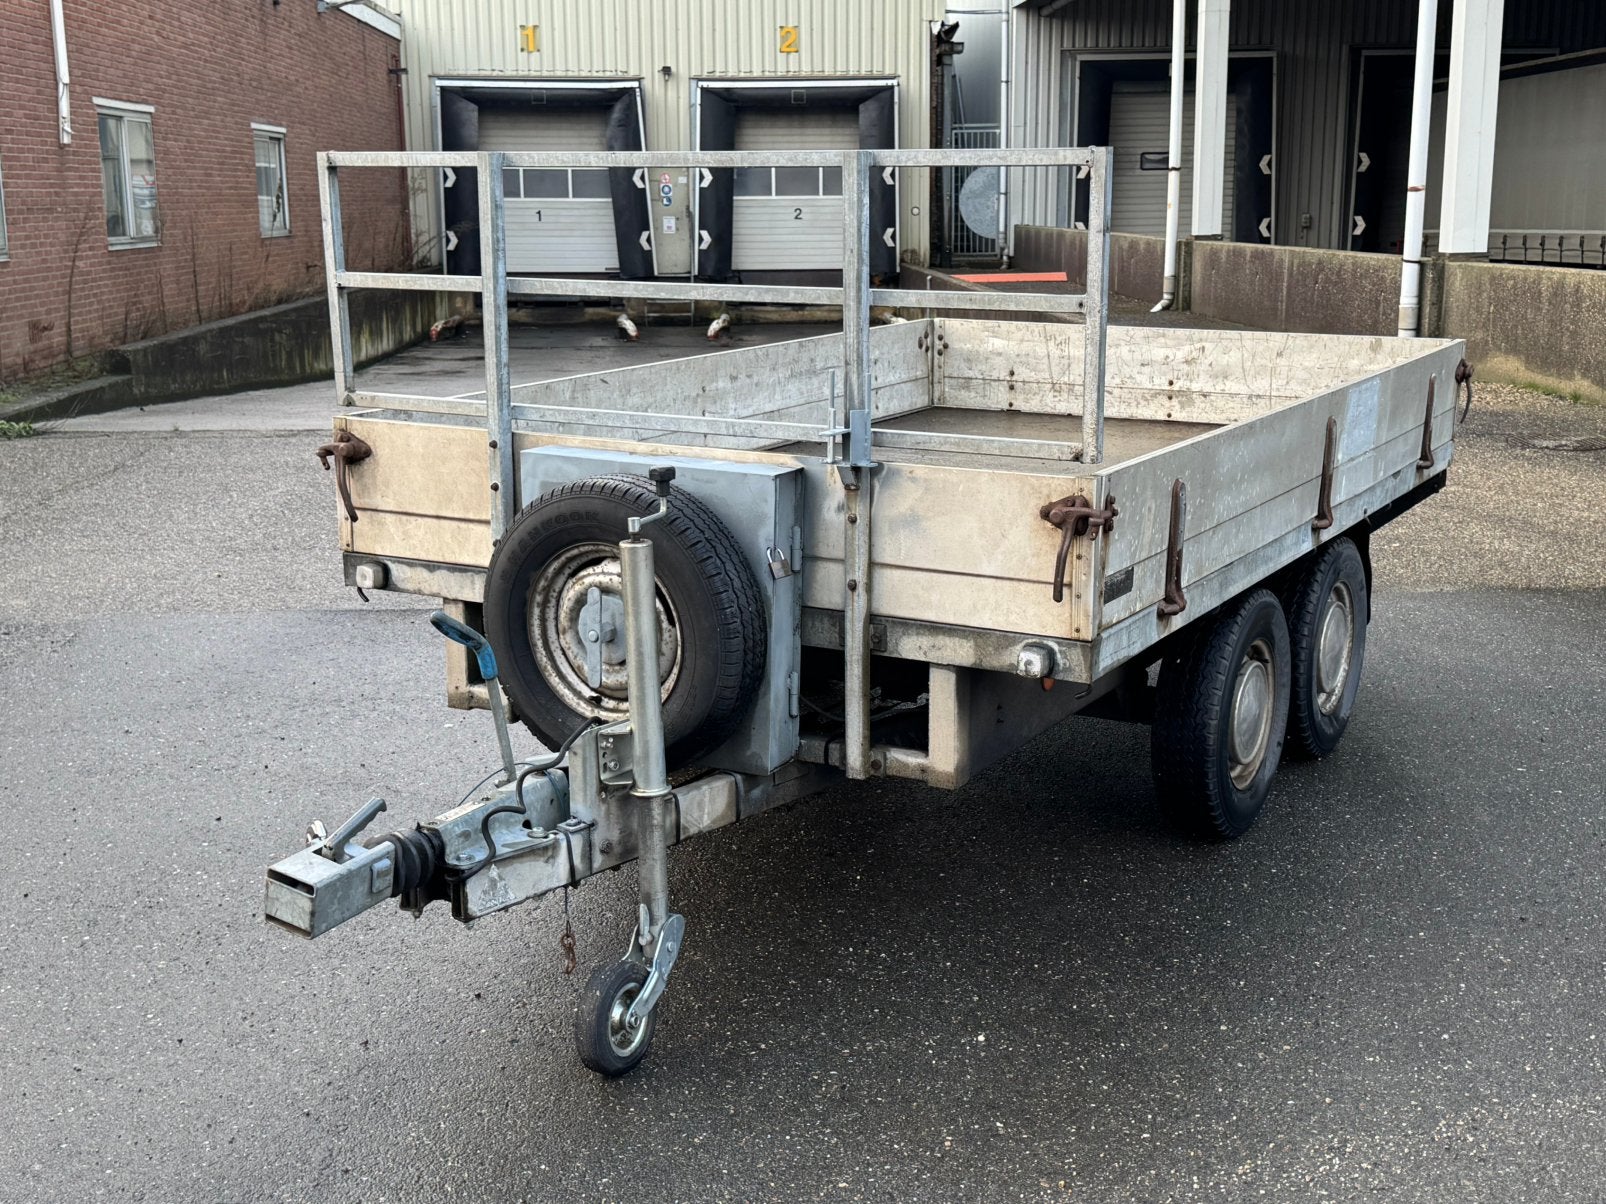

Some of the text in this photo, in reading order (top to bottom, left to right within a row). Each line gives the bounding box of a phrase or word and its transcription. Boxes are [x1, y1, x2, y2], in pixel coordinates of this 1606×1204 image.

[520, 25, 535, 52] 1
[780, 26, 798, 53] 2
[535, 209, 542, 222] 1
[794, 207, 803, 220] 2
